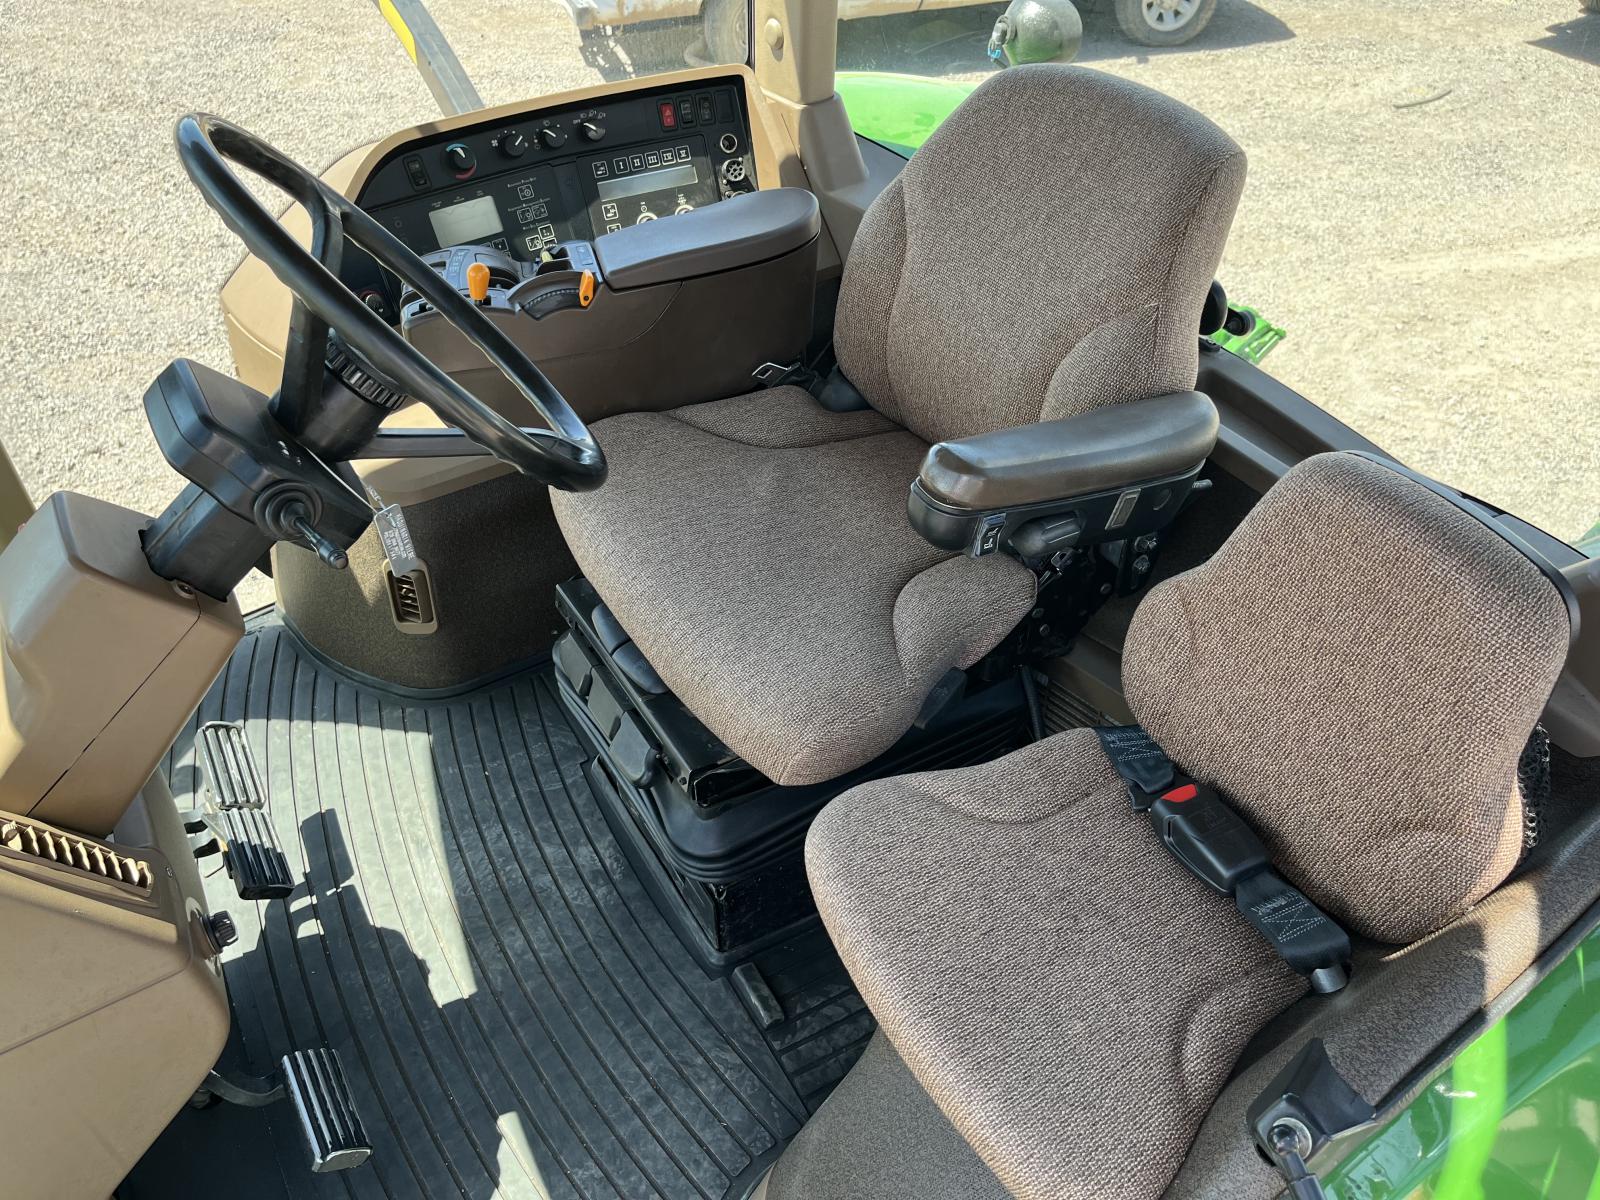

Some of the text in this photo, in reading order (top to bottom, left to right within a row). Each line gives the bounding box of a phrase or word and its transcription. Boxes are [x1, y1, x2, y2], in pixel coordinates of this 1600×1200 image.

[633, 158, 641, 167] II
[647, 155, 658, 164] III
[663, 152, 673, 161] IV
[679, 149, 688, 158] V
